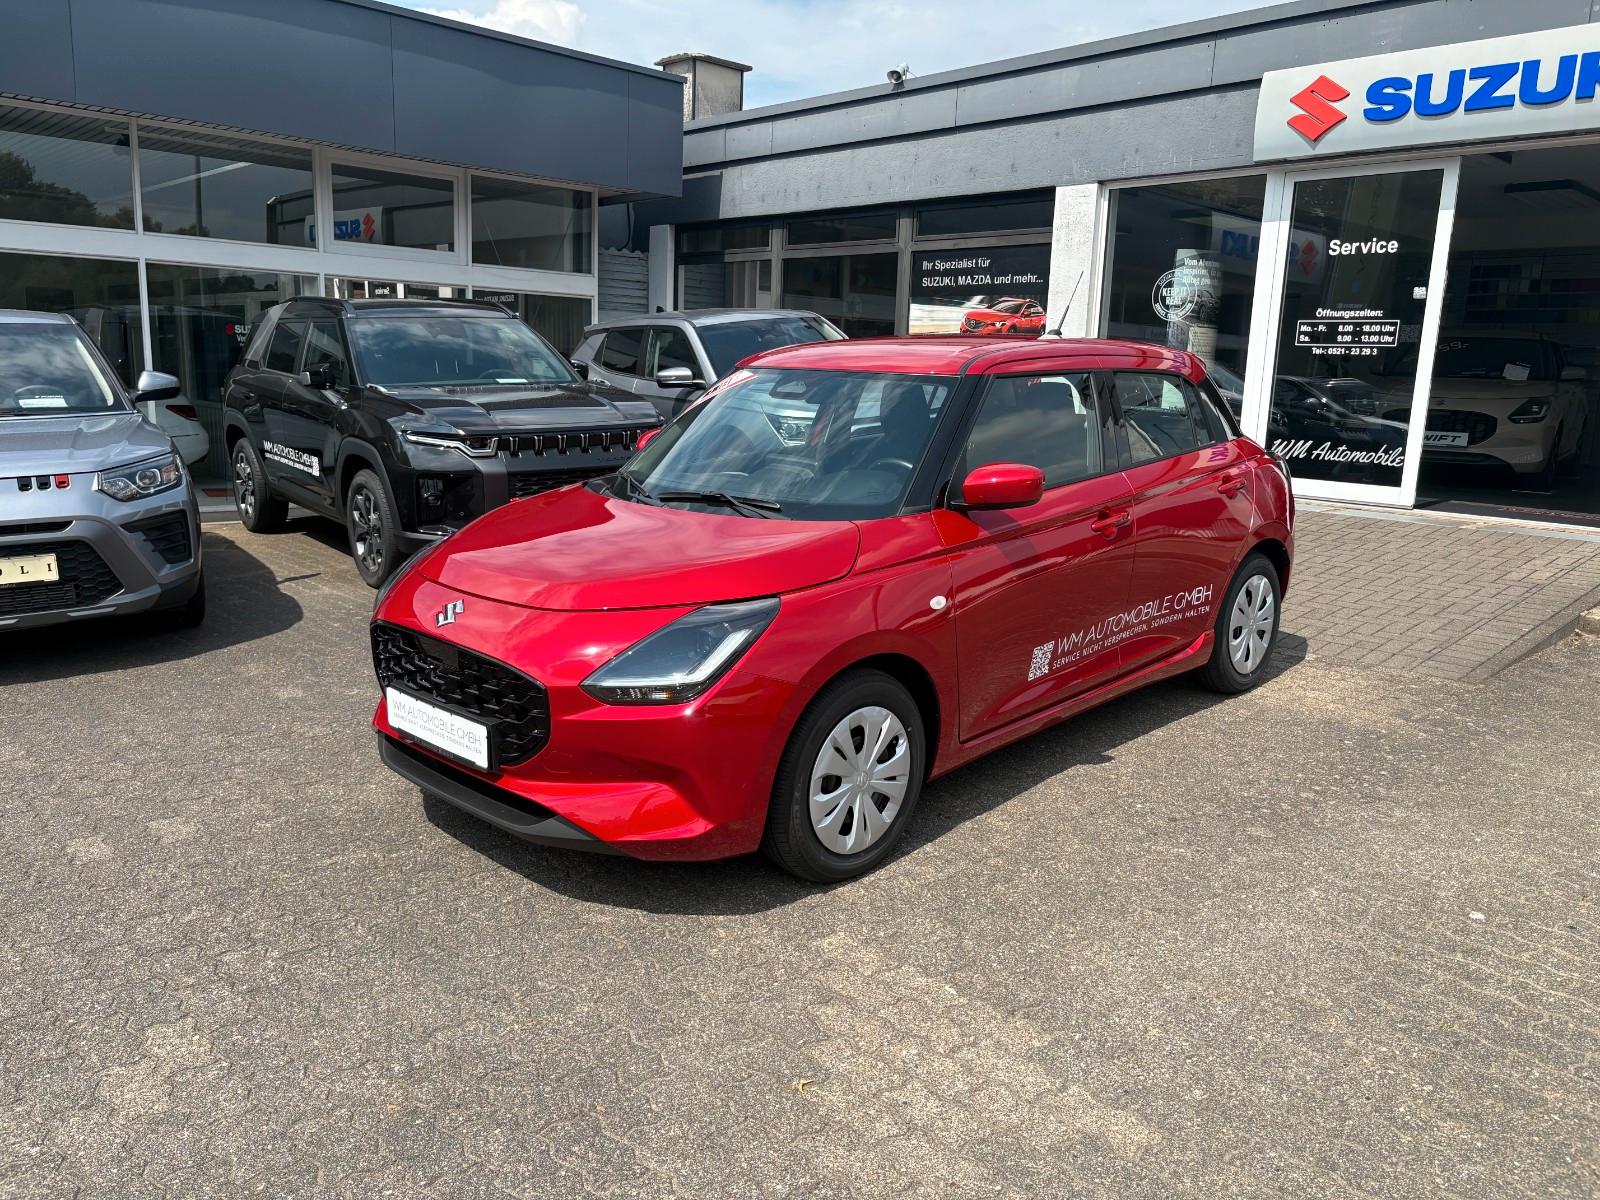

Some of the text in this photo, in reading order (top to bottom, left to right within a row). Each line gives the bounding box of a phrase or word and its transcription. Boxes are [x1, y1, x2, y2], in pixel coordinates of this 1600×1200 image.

[1328, 237, 1399, 256] Service
[922, 257, 991, 272] Ihr Spezialist für
[922, 272, 1044, 288] SUZUKI, MAZDA und mehr...
[1316, 308, 1383, 318] Öffnungszeiten:
[1360, 335, 1379, 343] 13.00
[1380, 335, 1394, 343] Uhr
[1327, 347, 1345, 355] 0521
[1350, 347, 1360, 355] 23
[1271, 438, 1404, 468] WM Automobile
[1057, 583, 1213, 656] WM AUTOMOBILE GMBH
[1052, 650, 1081, 670] SERVICE
[1082, 641, 1103, 657] NICHT
[1150, 613, 1183, 628] SONDERN
[1184, 605, 1210, 619] HALTEN
[407, 705, 456, 737] AUTOMOBILE
